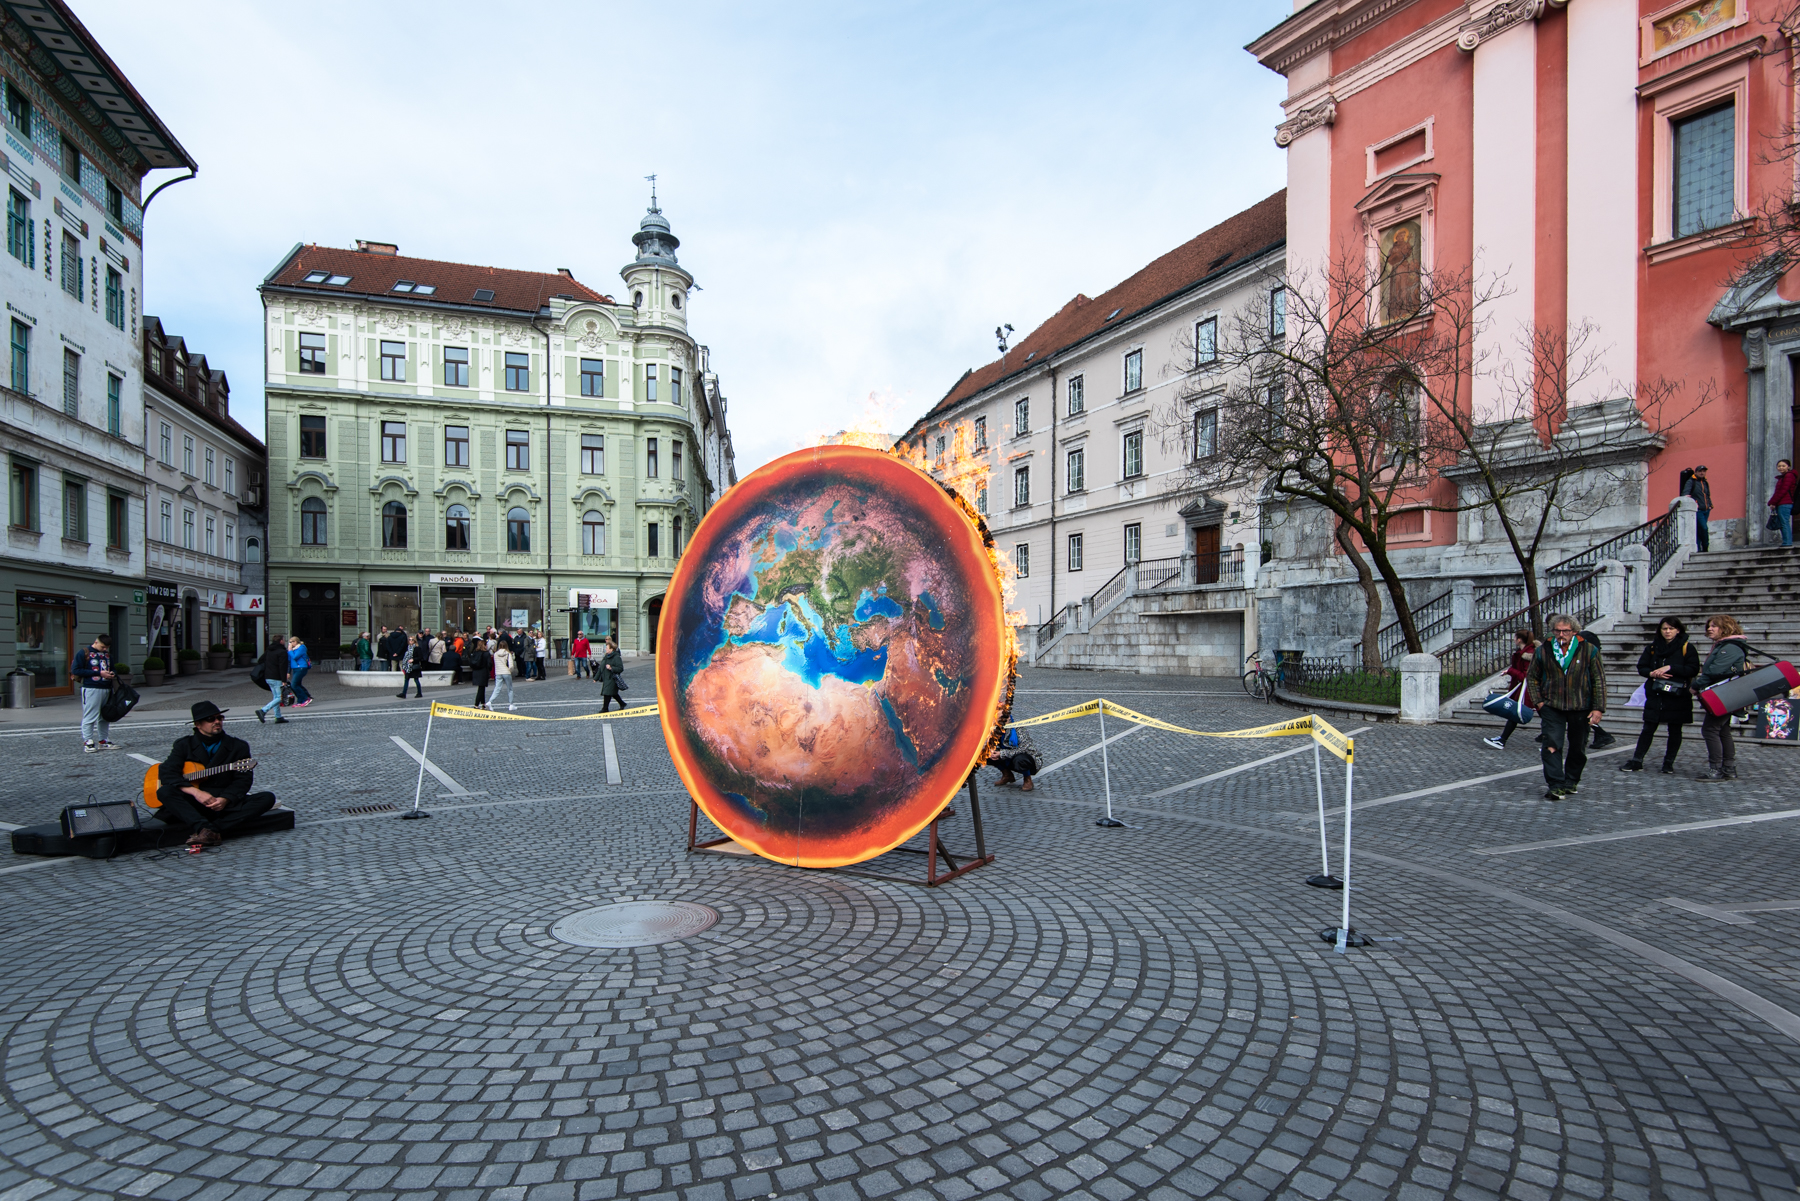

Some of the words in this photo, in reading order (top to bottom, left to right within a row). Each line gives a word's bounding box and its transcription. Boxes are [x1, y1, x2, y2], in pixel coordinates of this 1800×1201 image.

[249, 597, 262, 609] A1
[1287, 722, 1295, 730] ZA
[1295, 720, 1312, 730] SVOJ
